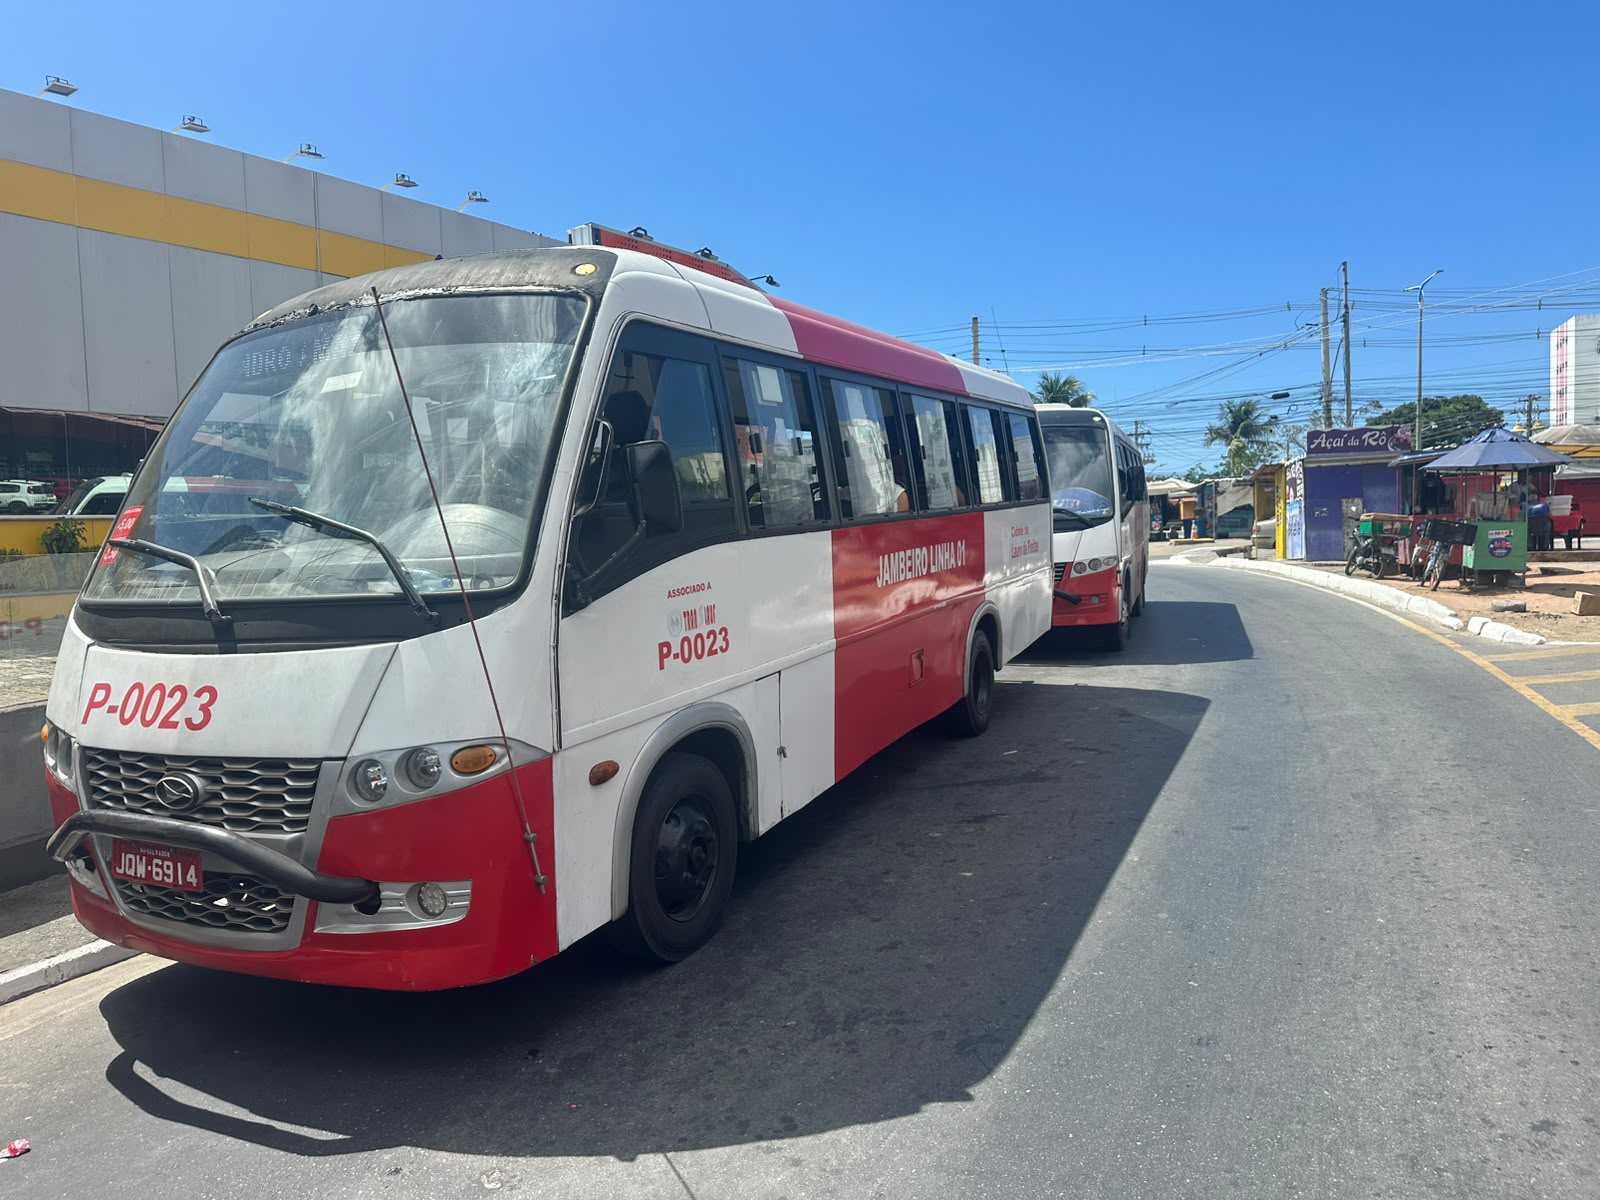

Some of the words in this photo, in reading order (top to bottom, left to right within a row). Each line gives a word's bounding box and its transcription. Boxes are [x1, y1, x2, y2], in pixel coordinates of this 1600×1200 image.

[1310, 433, 1348, 450] Açaí
[1347, 436, 1360, 446] da
[1361, 431, 1387, 447] Rô
[876, 546, 928, 588] JAMBEIRO
[930, 541, 956, 574] LINHA
[956, 538, 966, 568] 01
[667, 582, 706, 599] ASSOCIADO
[706, 581, 712, 590] A
[658, 626, 730, 671] P-0023
[81, 681, 218, 731] P-0023
